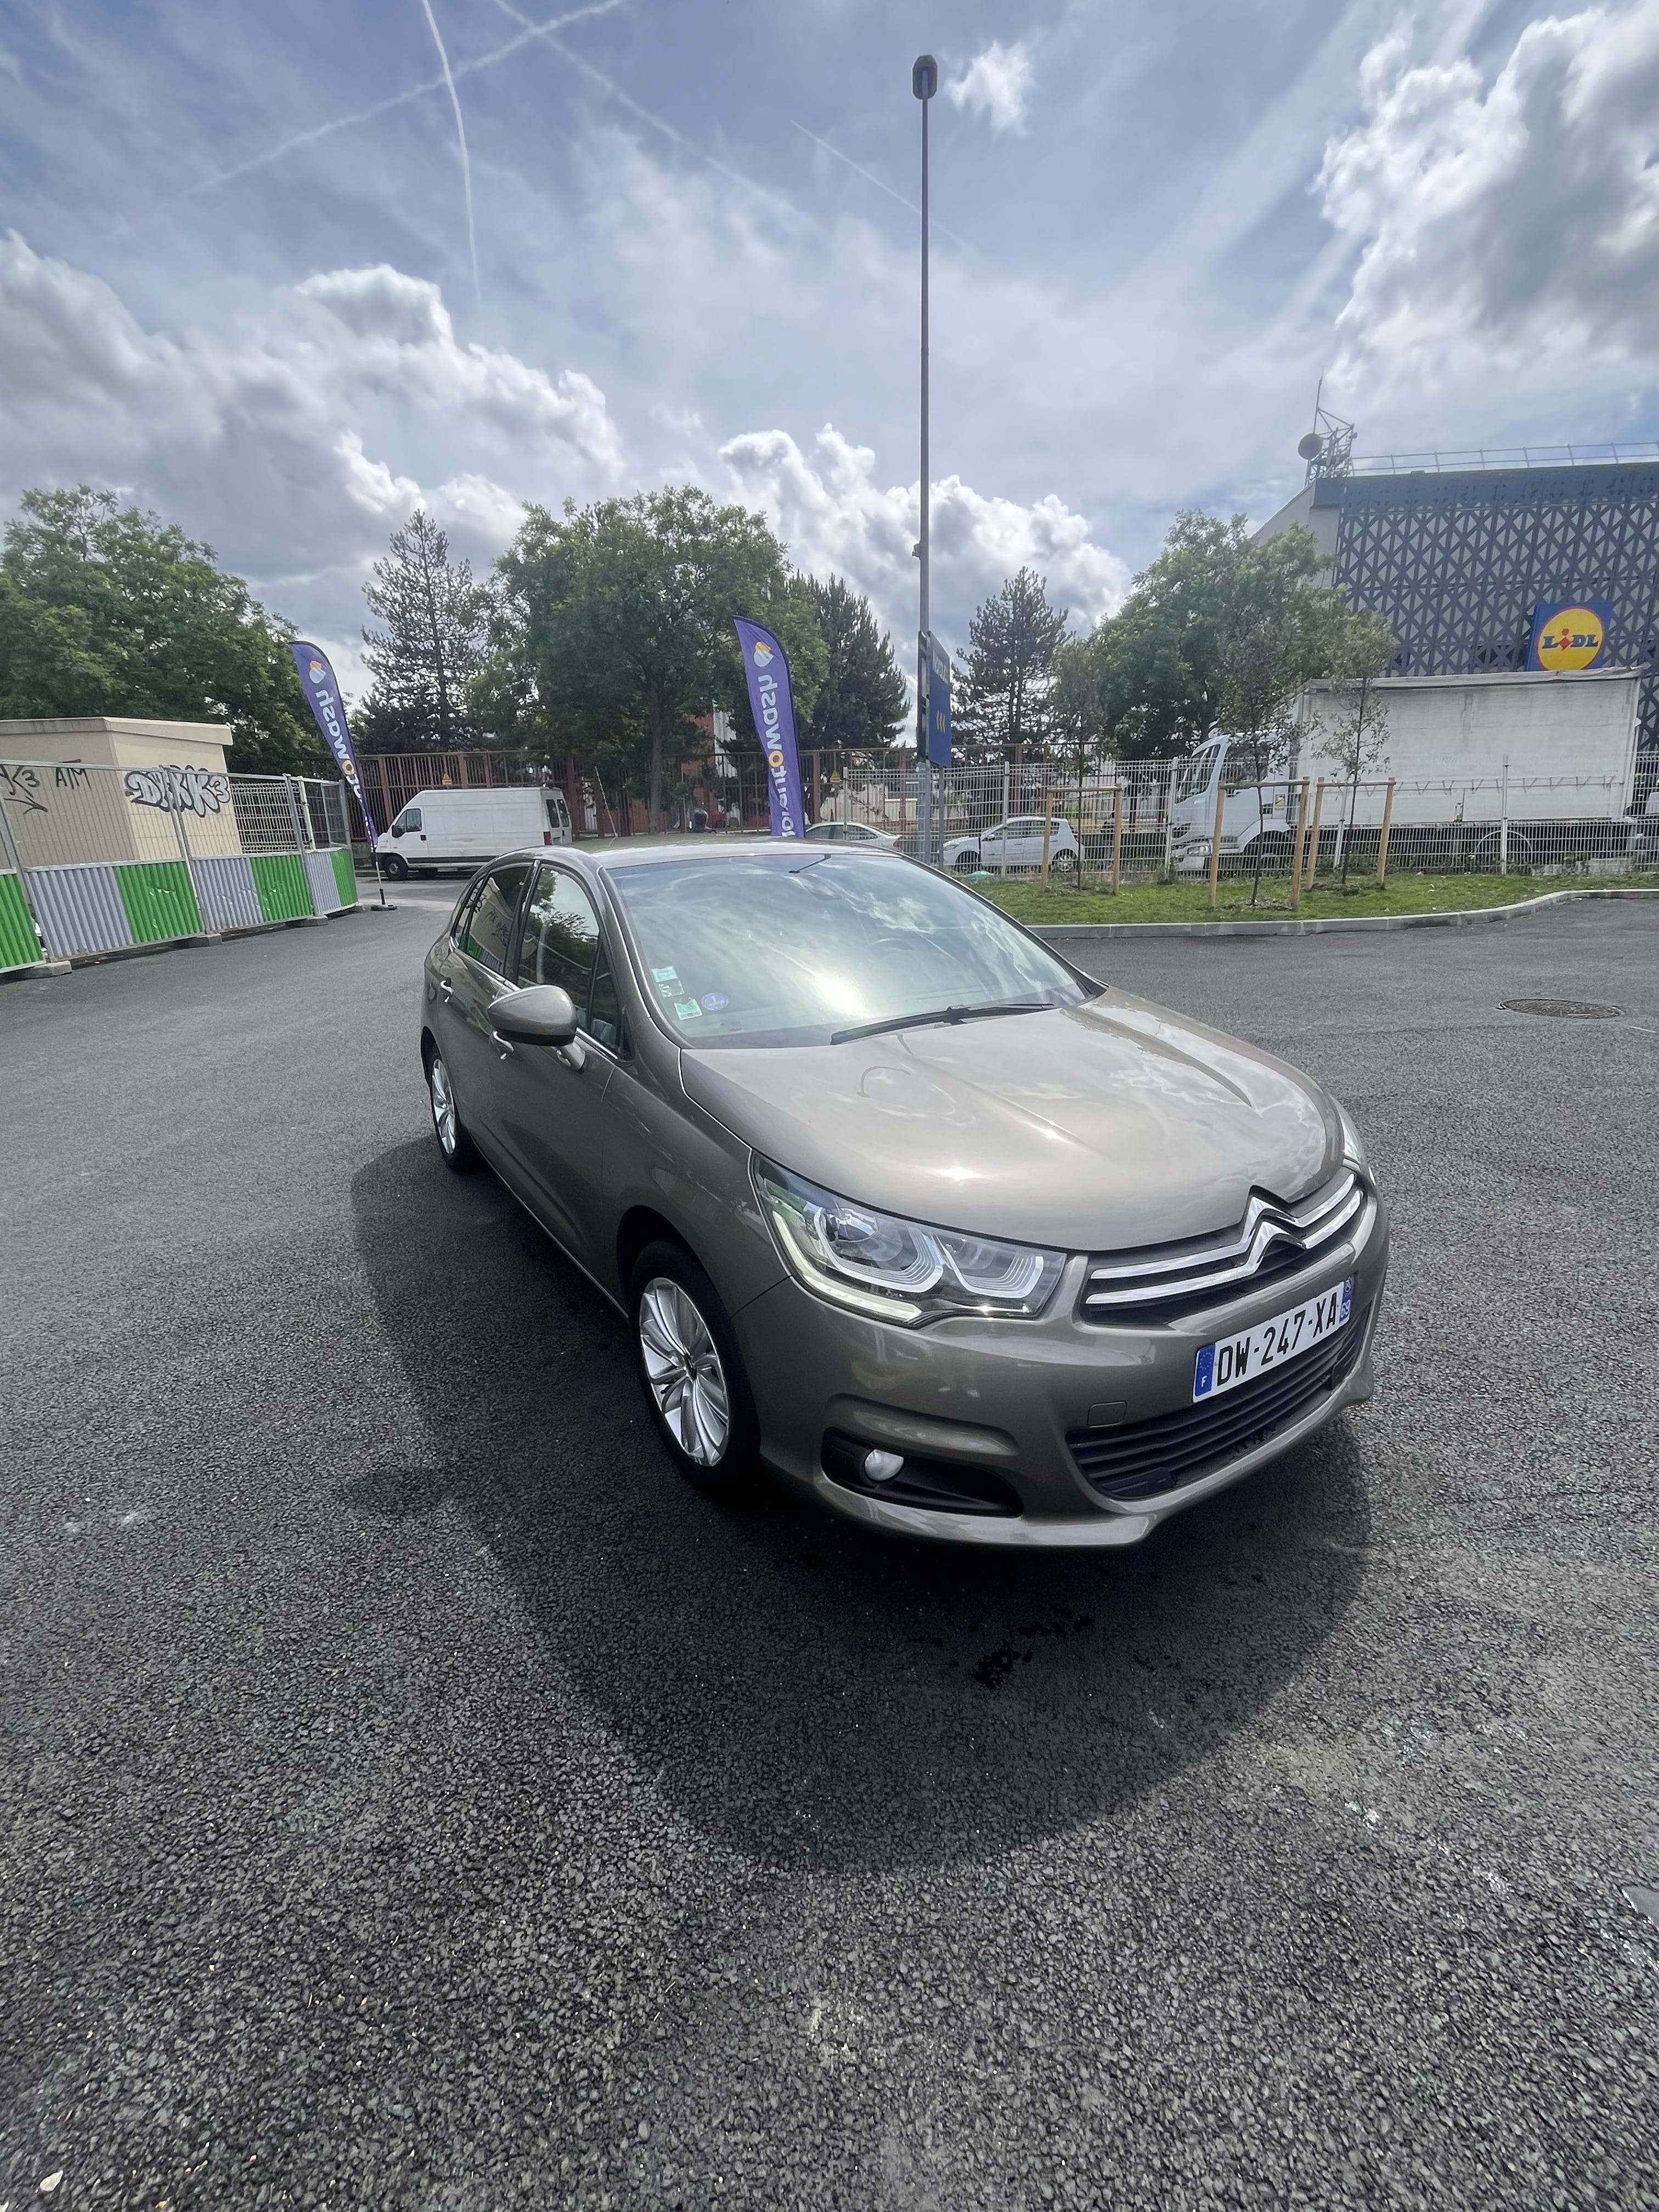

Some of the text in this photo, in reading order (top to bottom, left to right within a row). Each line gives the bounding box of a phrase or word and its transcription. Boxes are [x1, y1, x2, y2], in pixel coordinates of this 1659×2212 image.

[1340, 1299, 1351, 1318] 69
[1216, 1291, 1338, 1387] DW-247-XA
[1200, 1375, 1207, 1387] F
